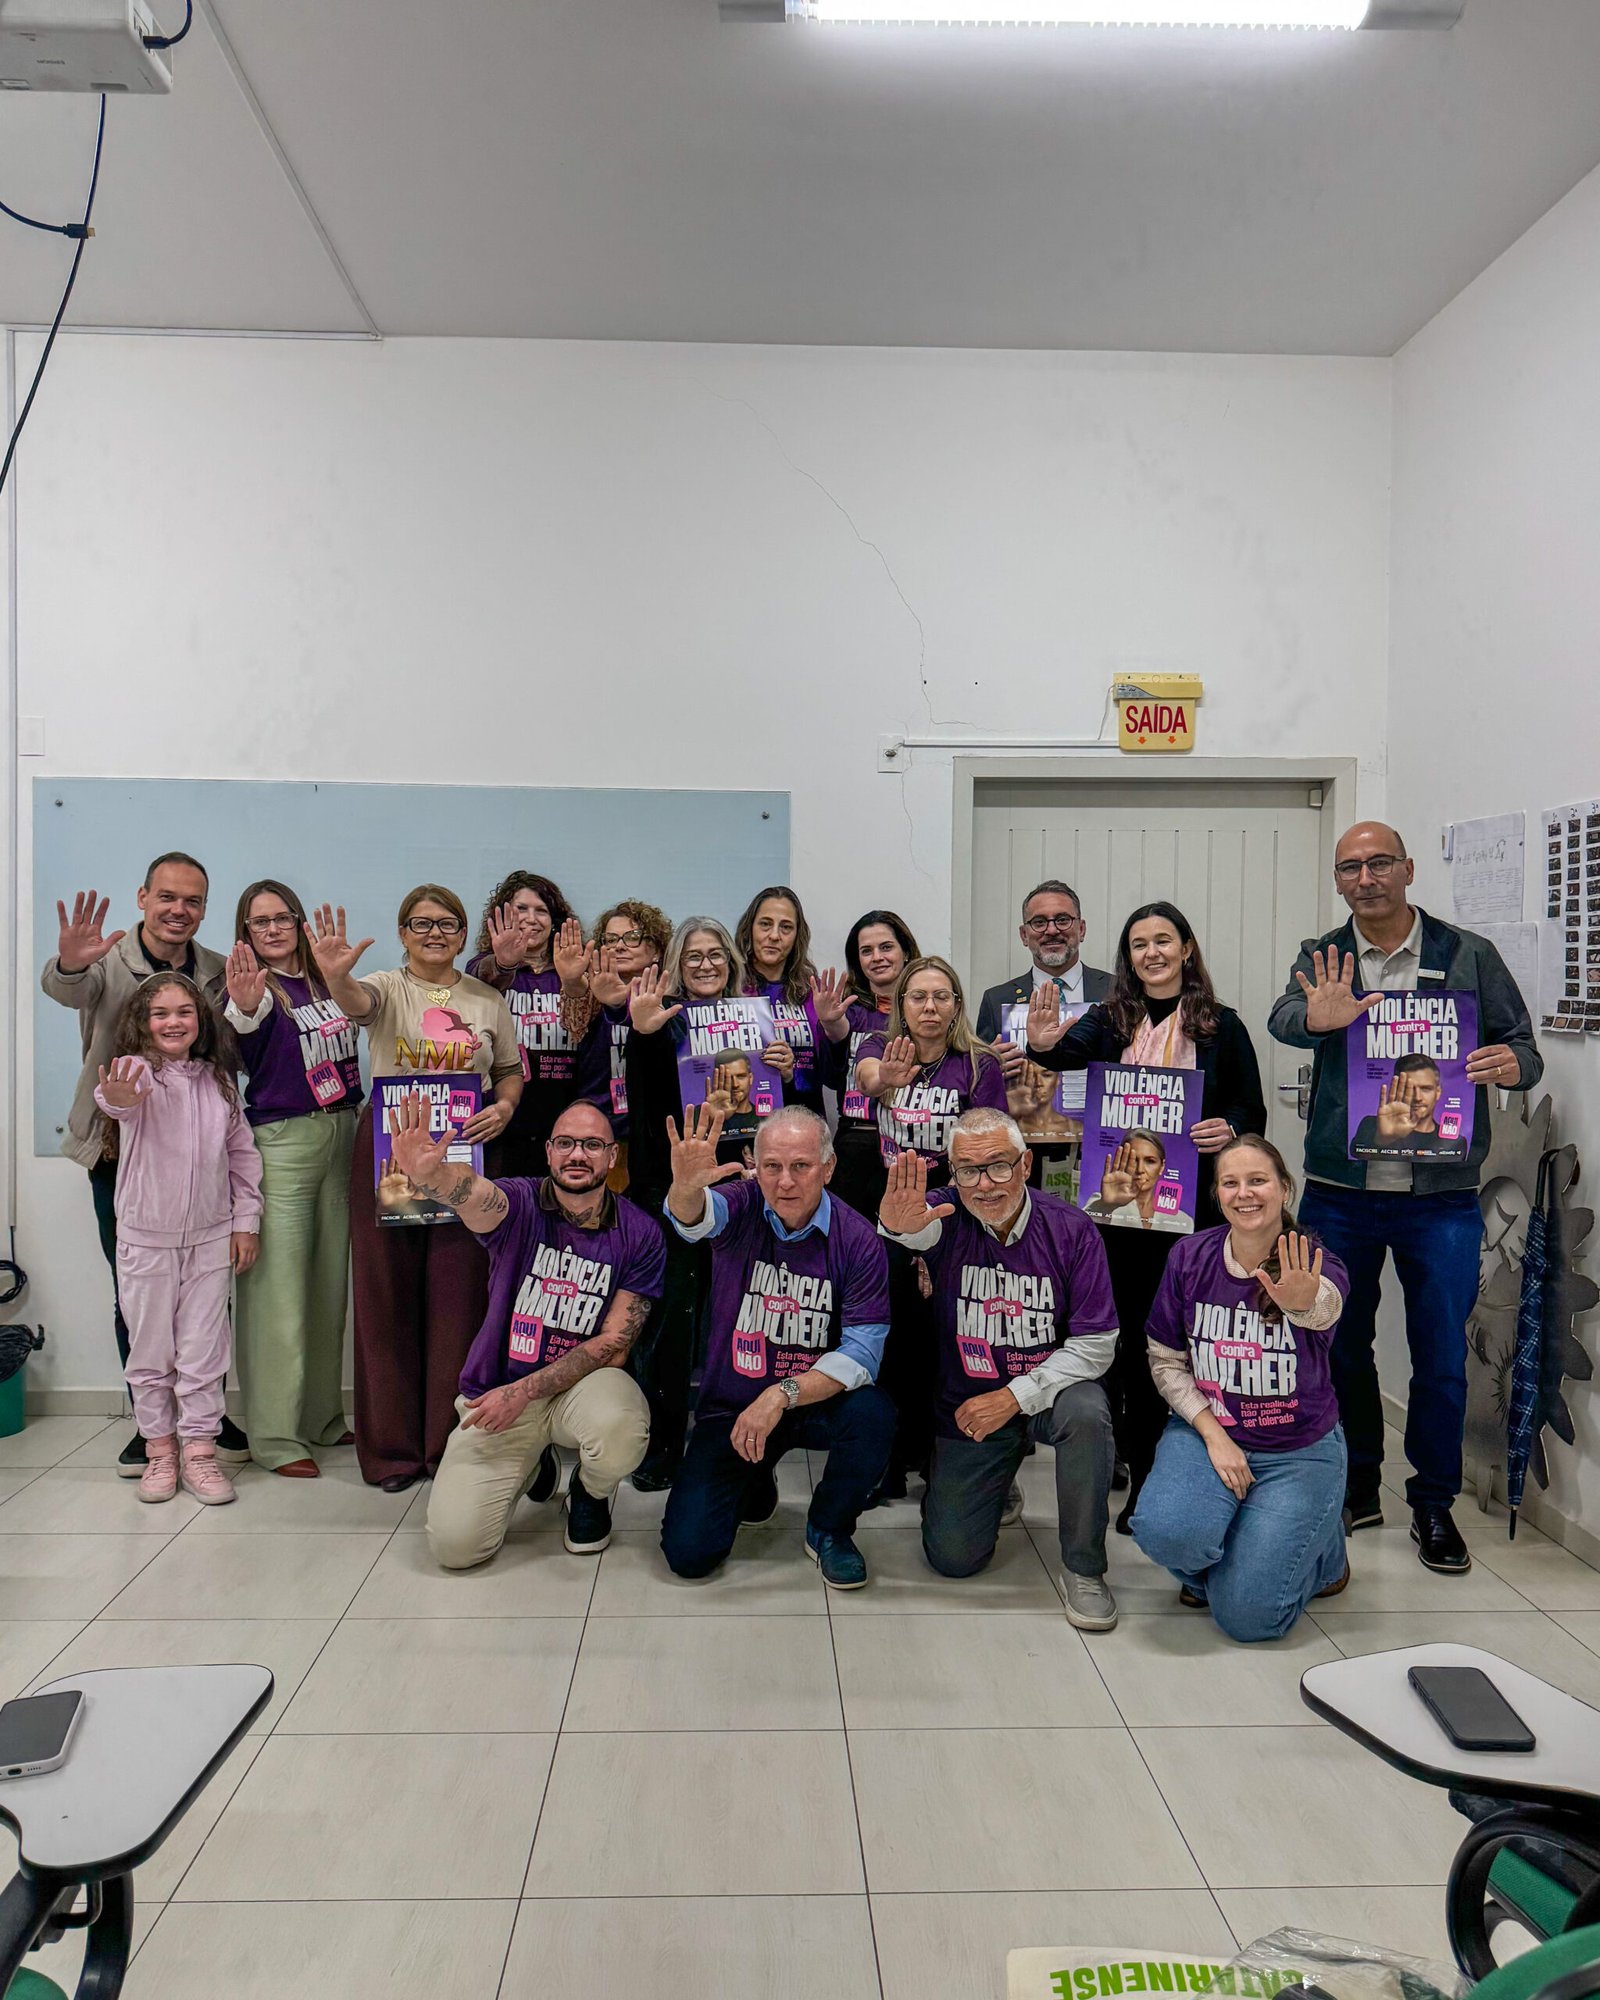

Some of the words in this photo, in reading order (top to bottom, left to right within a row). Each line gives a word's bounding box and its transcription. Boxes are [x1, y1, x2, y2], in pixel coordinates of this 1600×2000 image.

[1126, 704, 1187, 733] SAÍDA
[687, 1000, 759, 1027] VIOLÊNCIA
[1368, 992, 1458, 1024] VIOLÊNCIA
[526, 1015, 551, 1024] contra
[712, 1023, 734, 1032] contra
[1396, 1022, 1425, 1032] contra
[690, 1023, 763, 1056] MULHER
[1367, 1025, 1458, 1059] MULHER
[394, 1036, 475, 1071] NME
[316, 1078, 341, 1099] NÃO
[1105, 1067, 1184, 1100] VIOLÊNCIA
[1128, 1096, 1154, 1105] contra
[451, 1104, 471, 1117] NÃO
[897, 1112, 925, 1121] contra
[1101, 1095, 1184, 1134] MULHER
[1441, 1123, 1457, 1135] NÃO
[1159, 1186, 1178, 1197] AQUI
[1157, 1195, 1176, 1209] NÃO
[961, 1263, 1055, 1309] VIOLÊNCIA
[512, 1320, 536, 1337] AQUI
[736, 1293, 830, 1348] MULHER
[957, 1298, 1056, 1348] MULHER
[510, 1333, 535, 1355] NÃO
[962, 1342, 985, 1358] AQUI
[1221, 1345, 1255, 1357] contra
[736, 1350, 761, 1370] NÃO
[777, 1351, 792, 1359] Esta
[965, 1354, 992, 1372] NÃO
[1006, 1352, 1023, 1361] Esta
[1007, 1362, 1021, 1371] não
[1188, 1338, 1297, 1396] MULHER
[1243, 1418, 1257, 1427] ser
[1258, 1413, 1295, 1427] tolerada
